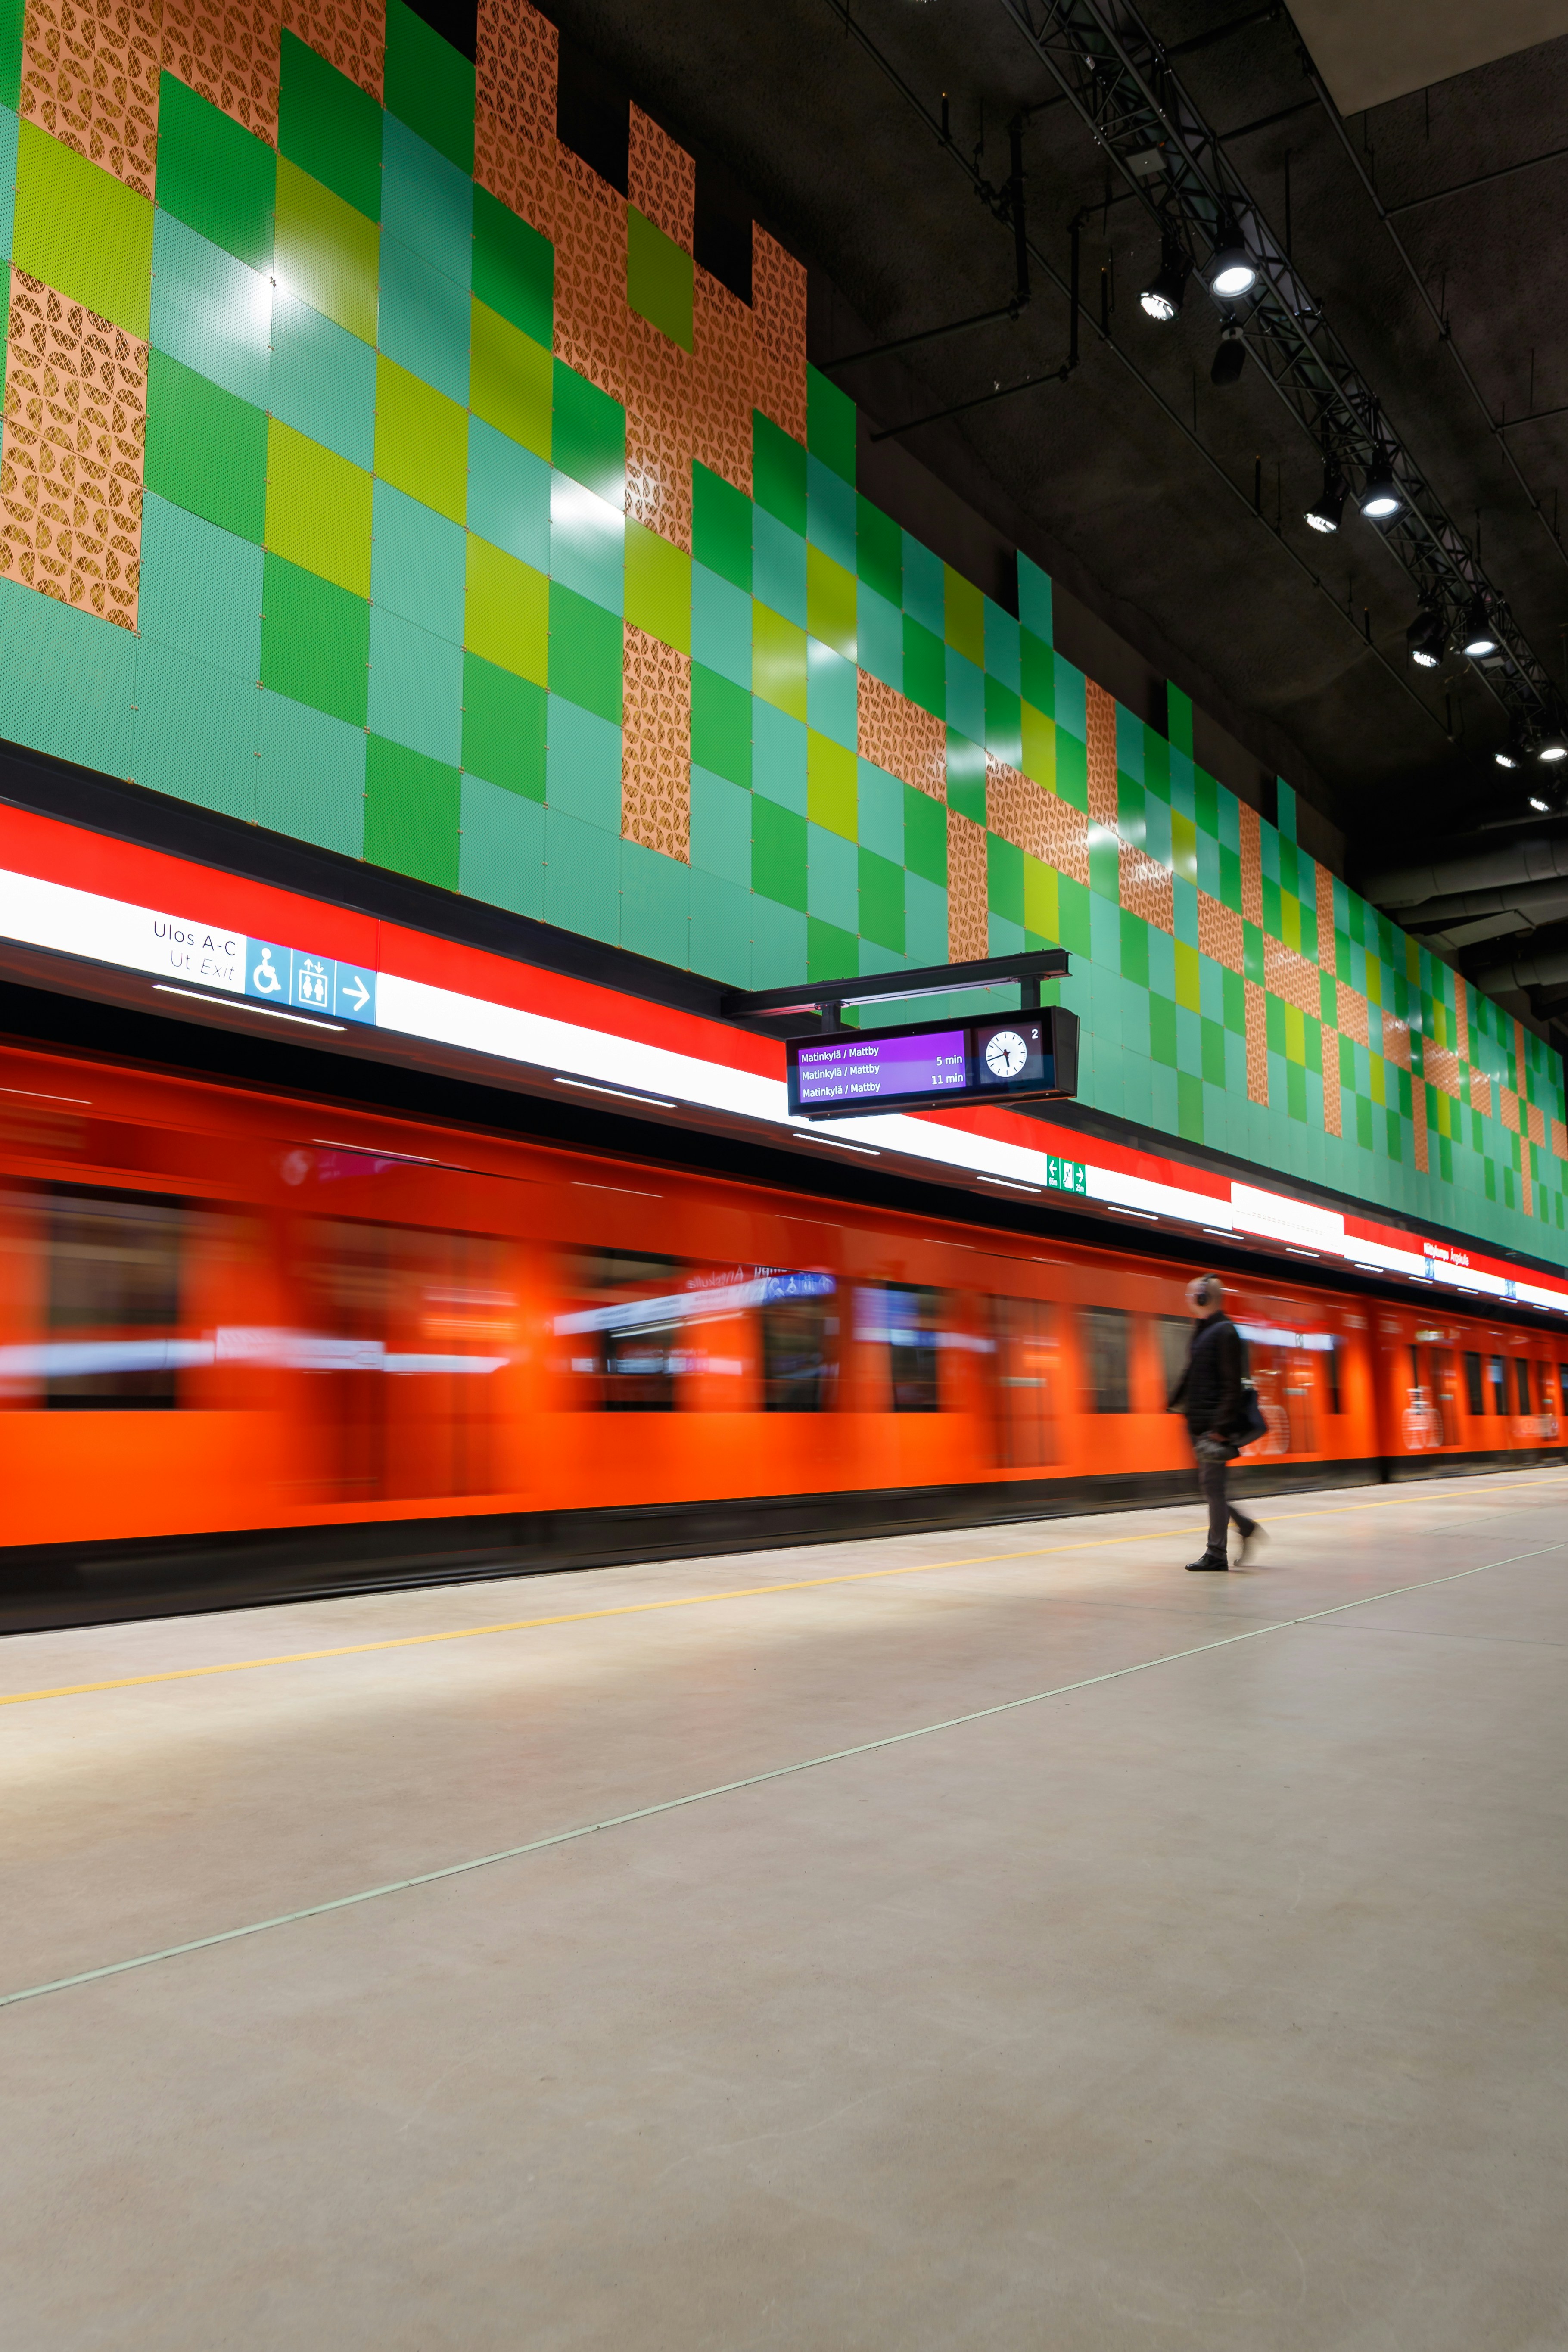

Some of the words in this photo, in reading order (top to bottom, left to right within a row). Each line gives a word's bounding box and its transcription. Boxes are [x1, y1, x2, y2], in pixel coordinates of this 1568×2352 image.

[154, 921, 194, 946] Ulos
[202, 935, 236, 956] A-C
[171, 950, 190, 970] Ut
[201, 958, 235, 980] Exit
[1031, 1028, 1039, 1039] 2
[801, 1050, 841, 1063] Matinkylä
[843, 1049, 847, 1059] /
[849, 1046, 879, 1057] Mattby
[802, 1067, 842, 1080] Matinkylä
[844, 1067, 848, 1077] /
[850, 1064, 880, 1075] Mattby
[936, 1056, 943, 1066] 5
[945, 1055, 963, 1065] min
[803, 1085, 843, 1098] Matinkylä
[845, 1084, 849, 1095] /
[850, 1082, 881, 1092] Mattby
[931, 1075, 943, 1085] 11
[946, 1073, 964, 1083] min
